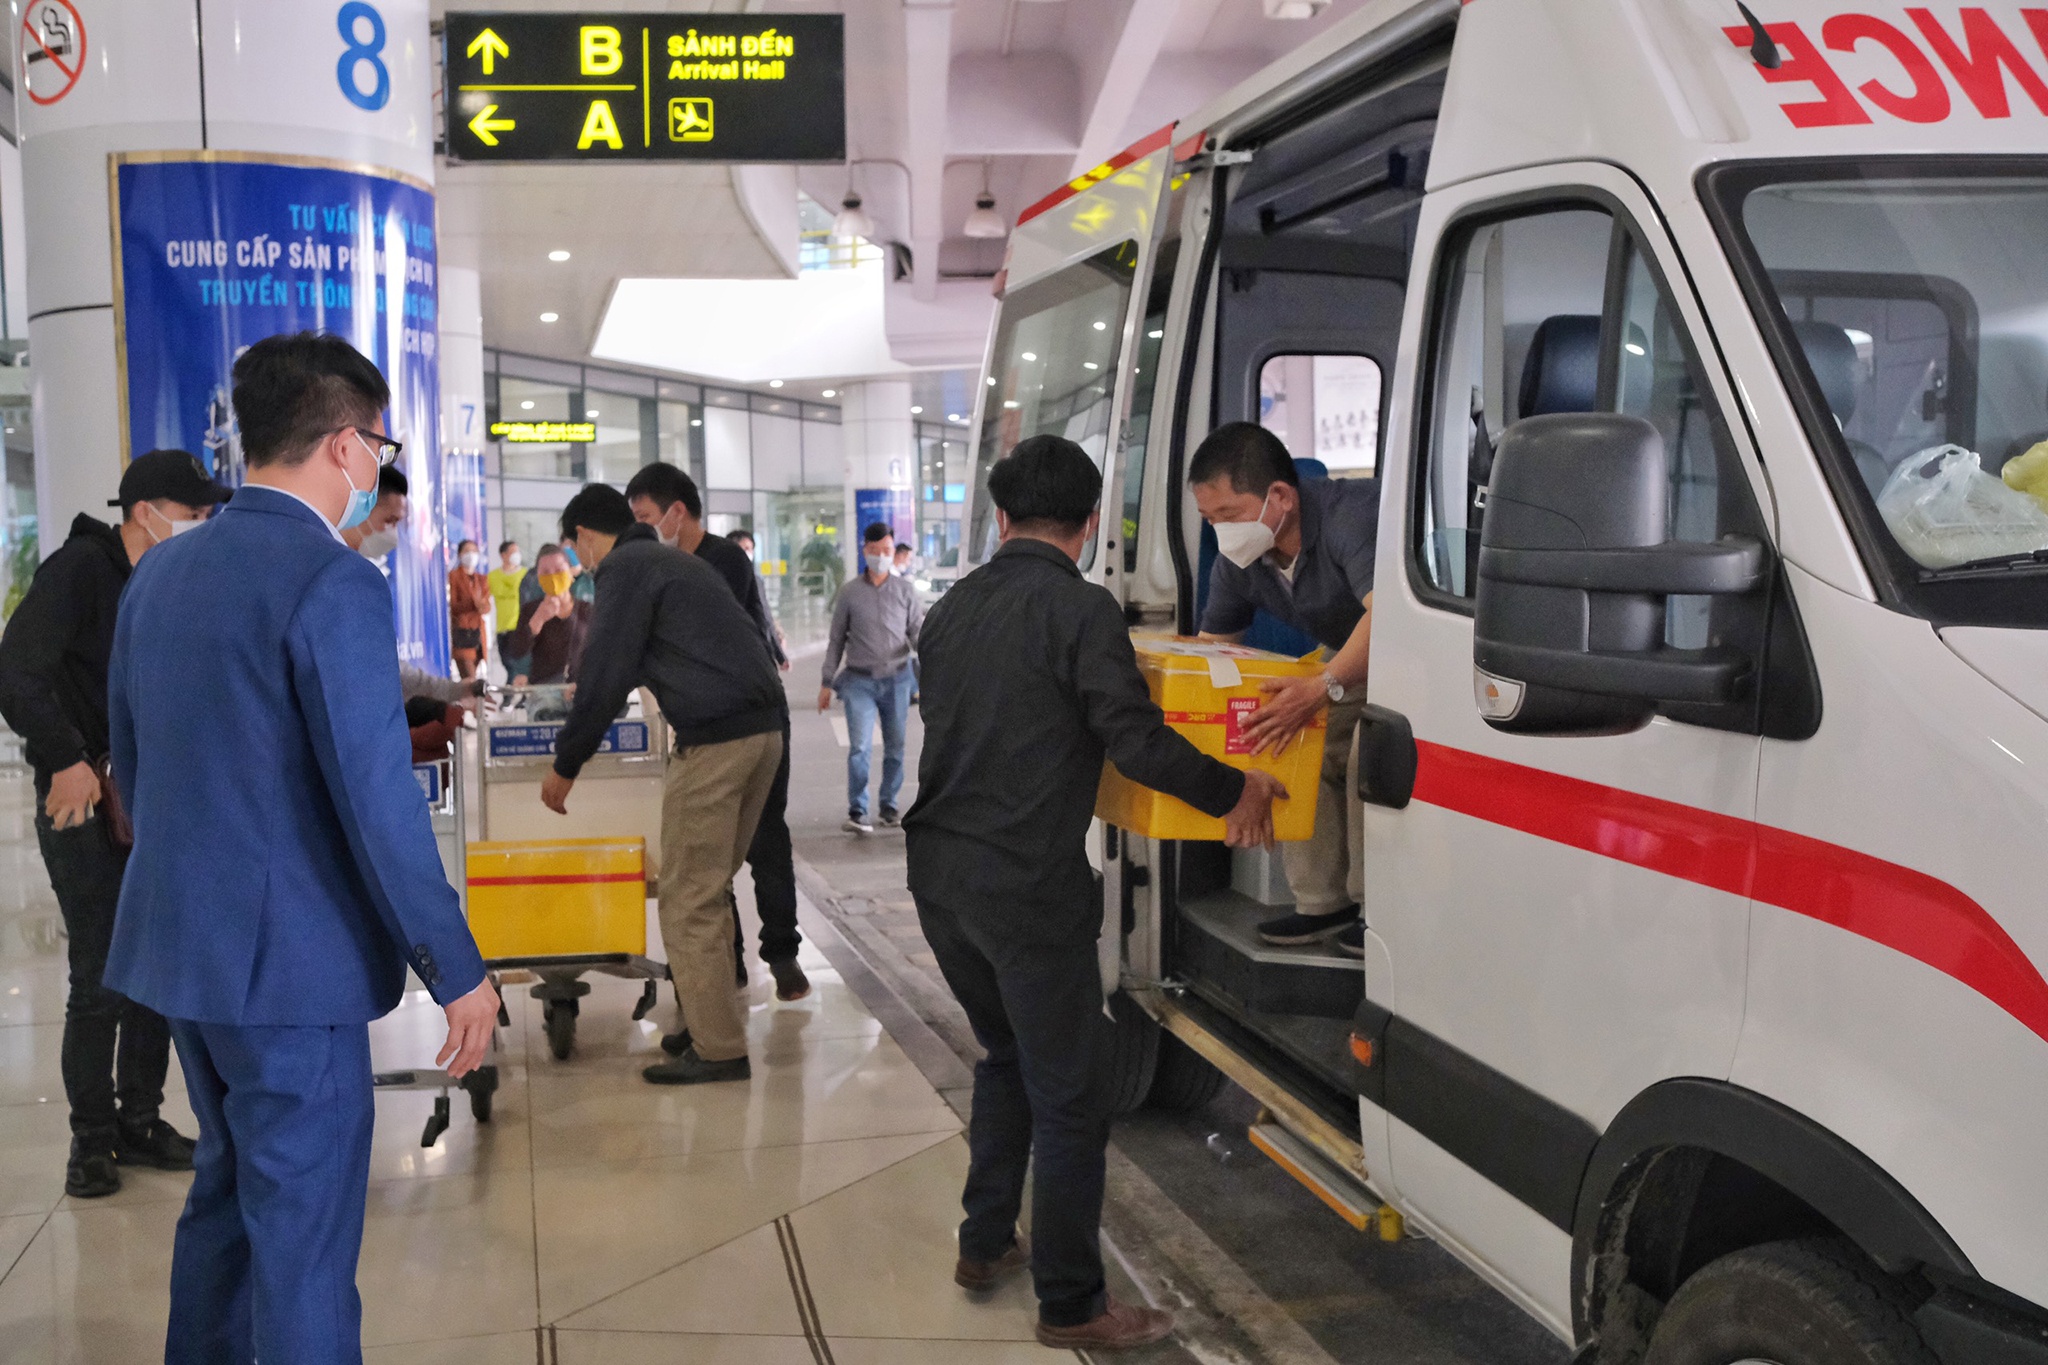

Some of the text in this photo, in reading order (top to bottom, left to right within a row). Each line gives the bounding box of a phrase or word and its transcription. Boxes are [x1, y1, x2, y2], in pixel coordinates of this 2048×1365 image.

[337, 1, 391, 111] 8
[580, 25, 623, 75] B
[667, 28, 794, 57] SẢNH ĐẾN
[668, 60, 785, 80] Arrival Hall
[577, 100, 624, 149] A
[166, 240, 228, 268] CUNG
[236, 233, 282, 268] CẤP
[288, 235, 332, 270] SẢN
[461, 404, 475, 435] 7
[1231, 701, 1257, 711] FRAGILE
